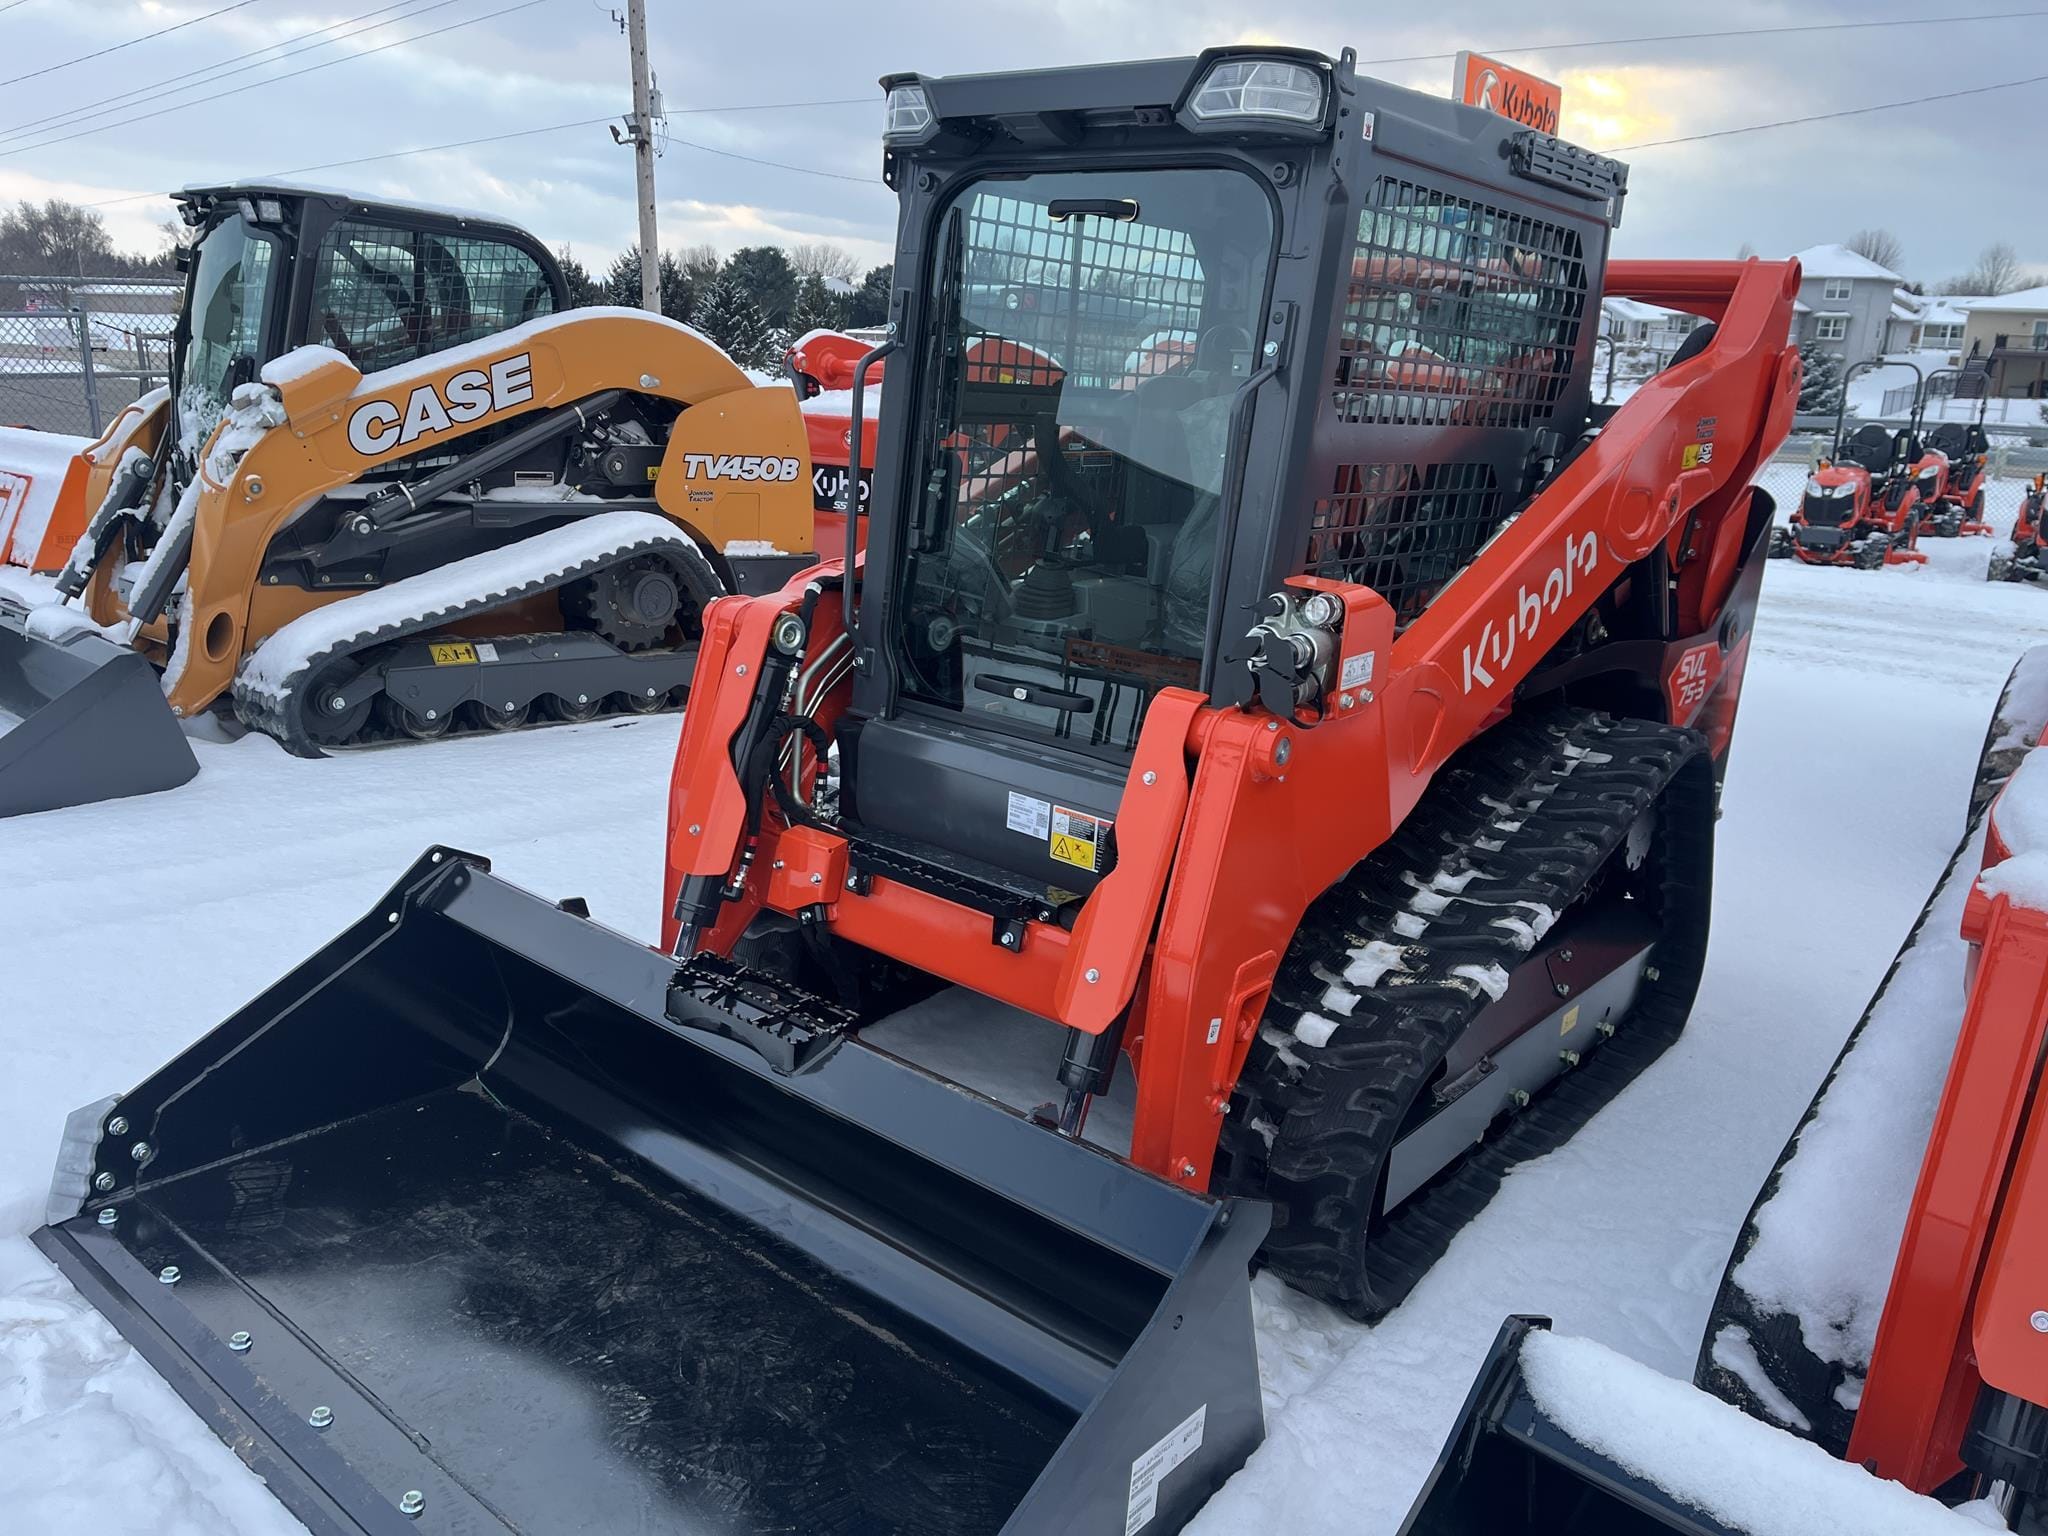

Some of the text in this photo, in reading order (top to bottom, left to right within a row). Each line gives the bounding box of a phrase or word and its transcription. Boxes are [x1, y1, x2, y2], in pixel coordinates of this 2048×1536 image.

[1502, 81, 1557, 134] Kubota
[347, 351, 534, 456] CASE
[683, 453, 800, 481] TV450B
[1463, 530, 1598, 695] Kubota
[1677, 651, 1707, 684] SVL
